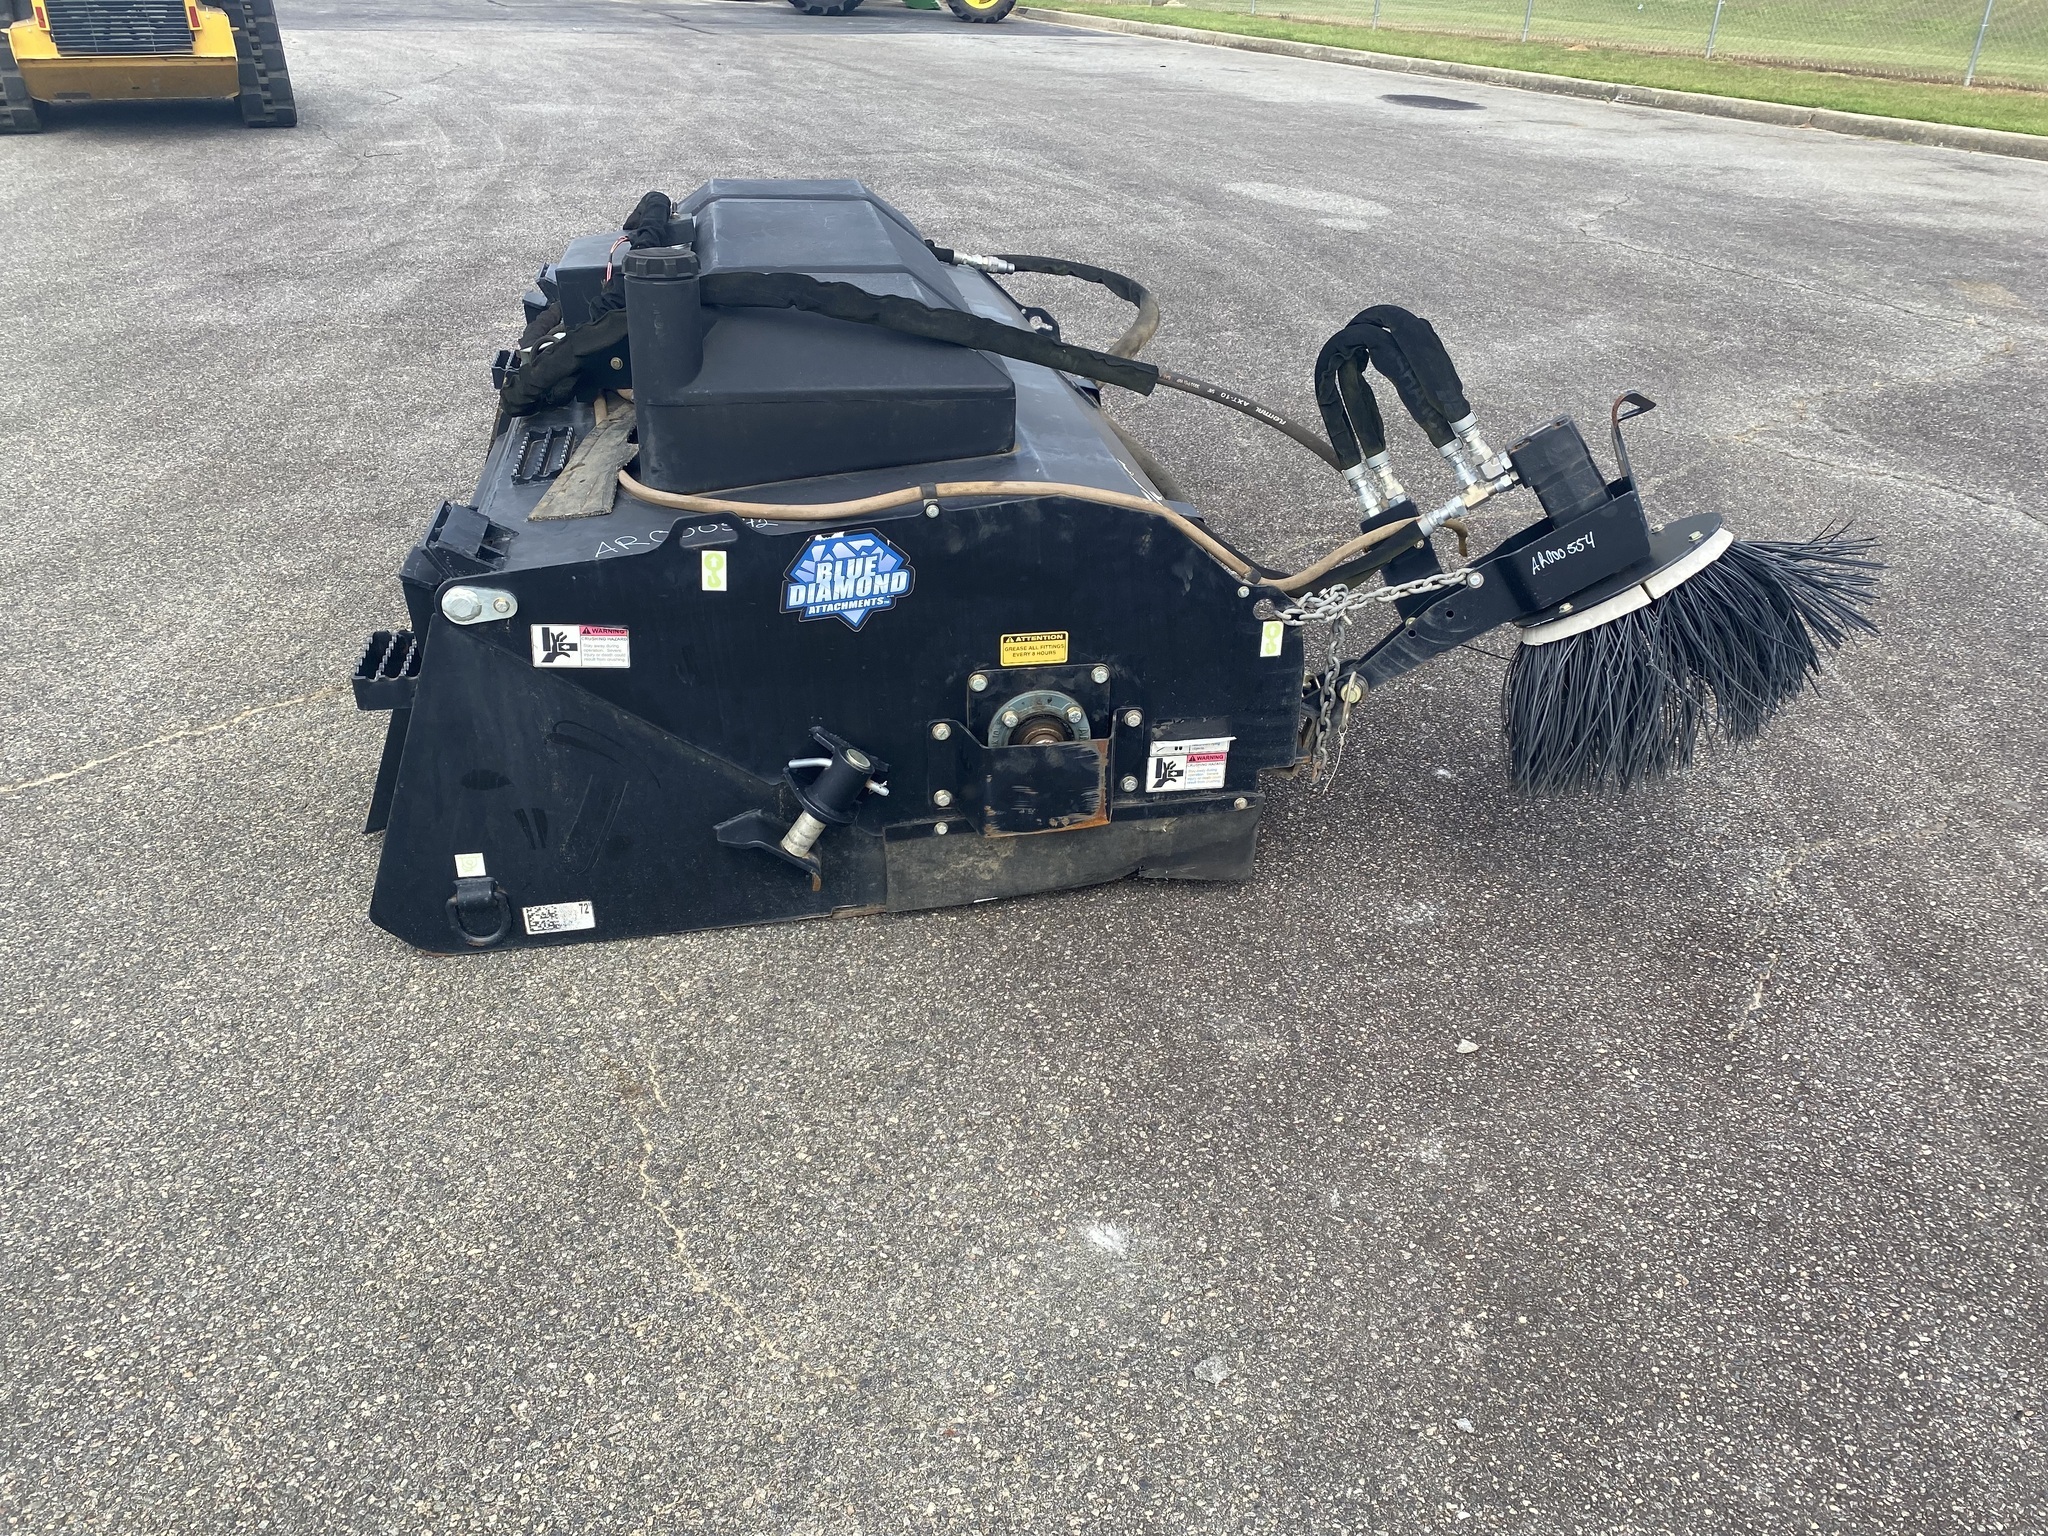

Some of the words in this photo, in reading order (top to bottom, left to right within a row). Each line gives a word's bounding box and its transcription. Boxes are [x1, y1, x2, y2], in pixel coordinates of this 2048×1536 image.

[1220, 392, 1250, 407] AXT-10
[815, 555, 878, 583] BLUE
[789, 571, 908, 606] DIAMOND
[1015, 634, 1063, 642] ATTENTION
